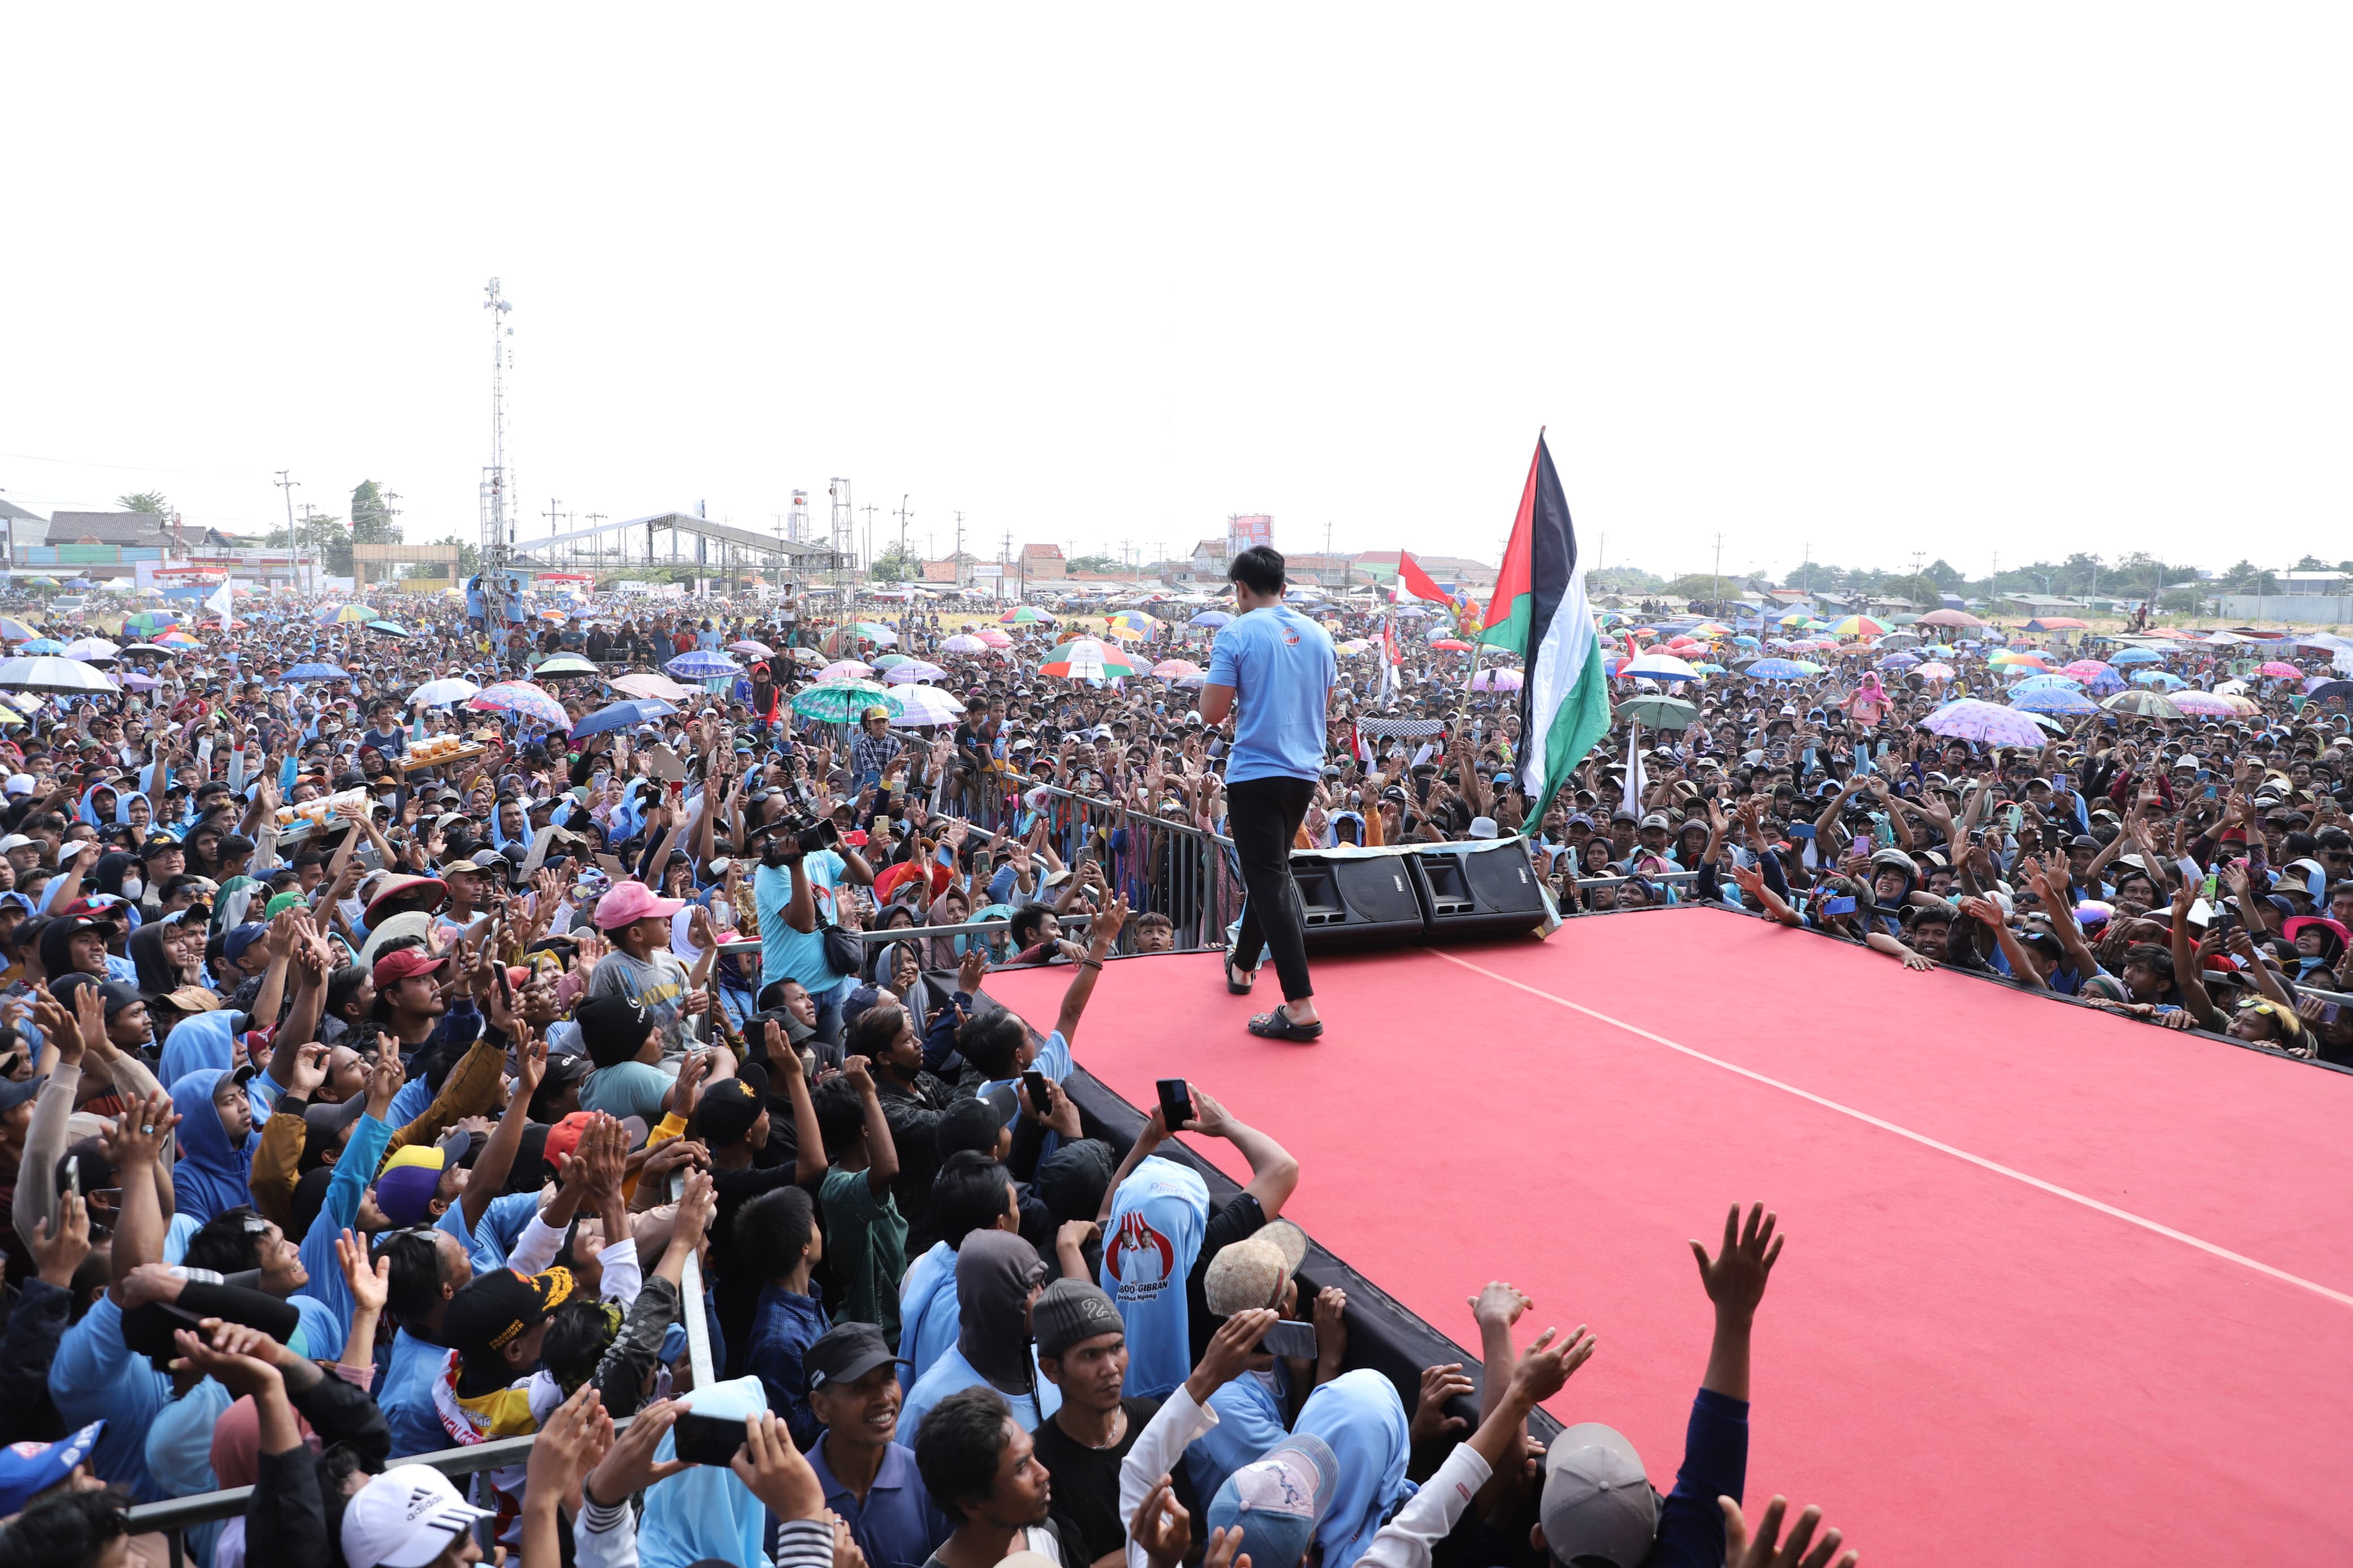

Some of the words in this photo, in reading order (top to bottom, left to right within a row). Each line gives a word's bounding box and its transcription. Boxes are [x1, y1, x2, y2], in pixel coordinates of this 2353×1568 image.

[489, 1319, 519, 1347] PRABOWO
[493, 1323, 524, 1350] PRESIDEN
[407, 1495, 444, 1521] adidas
